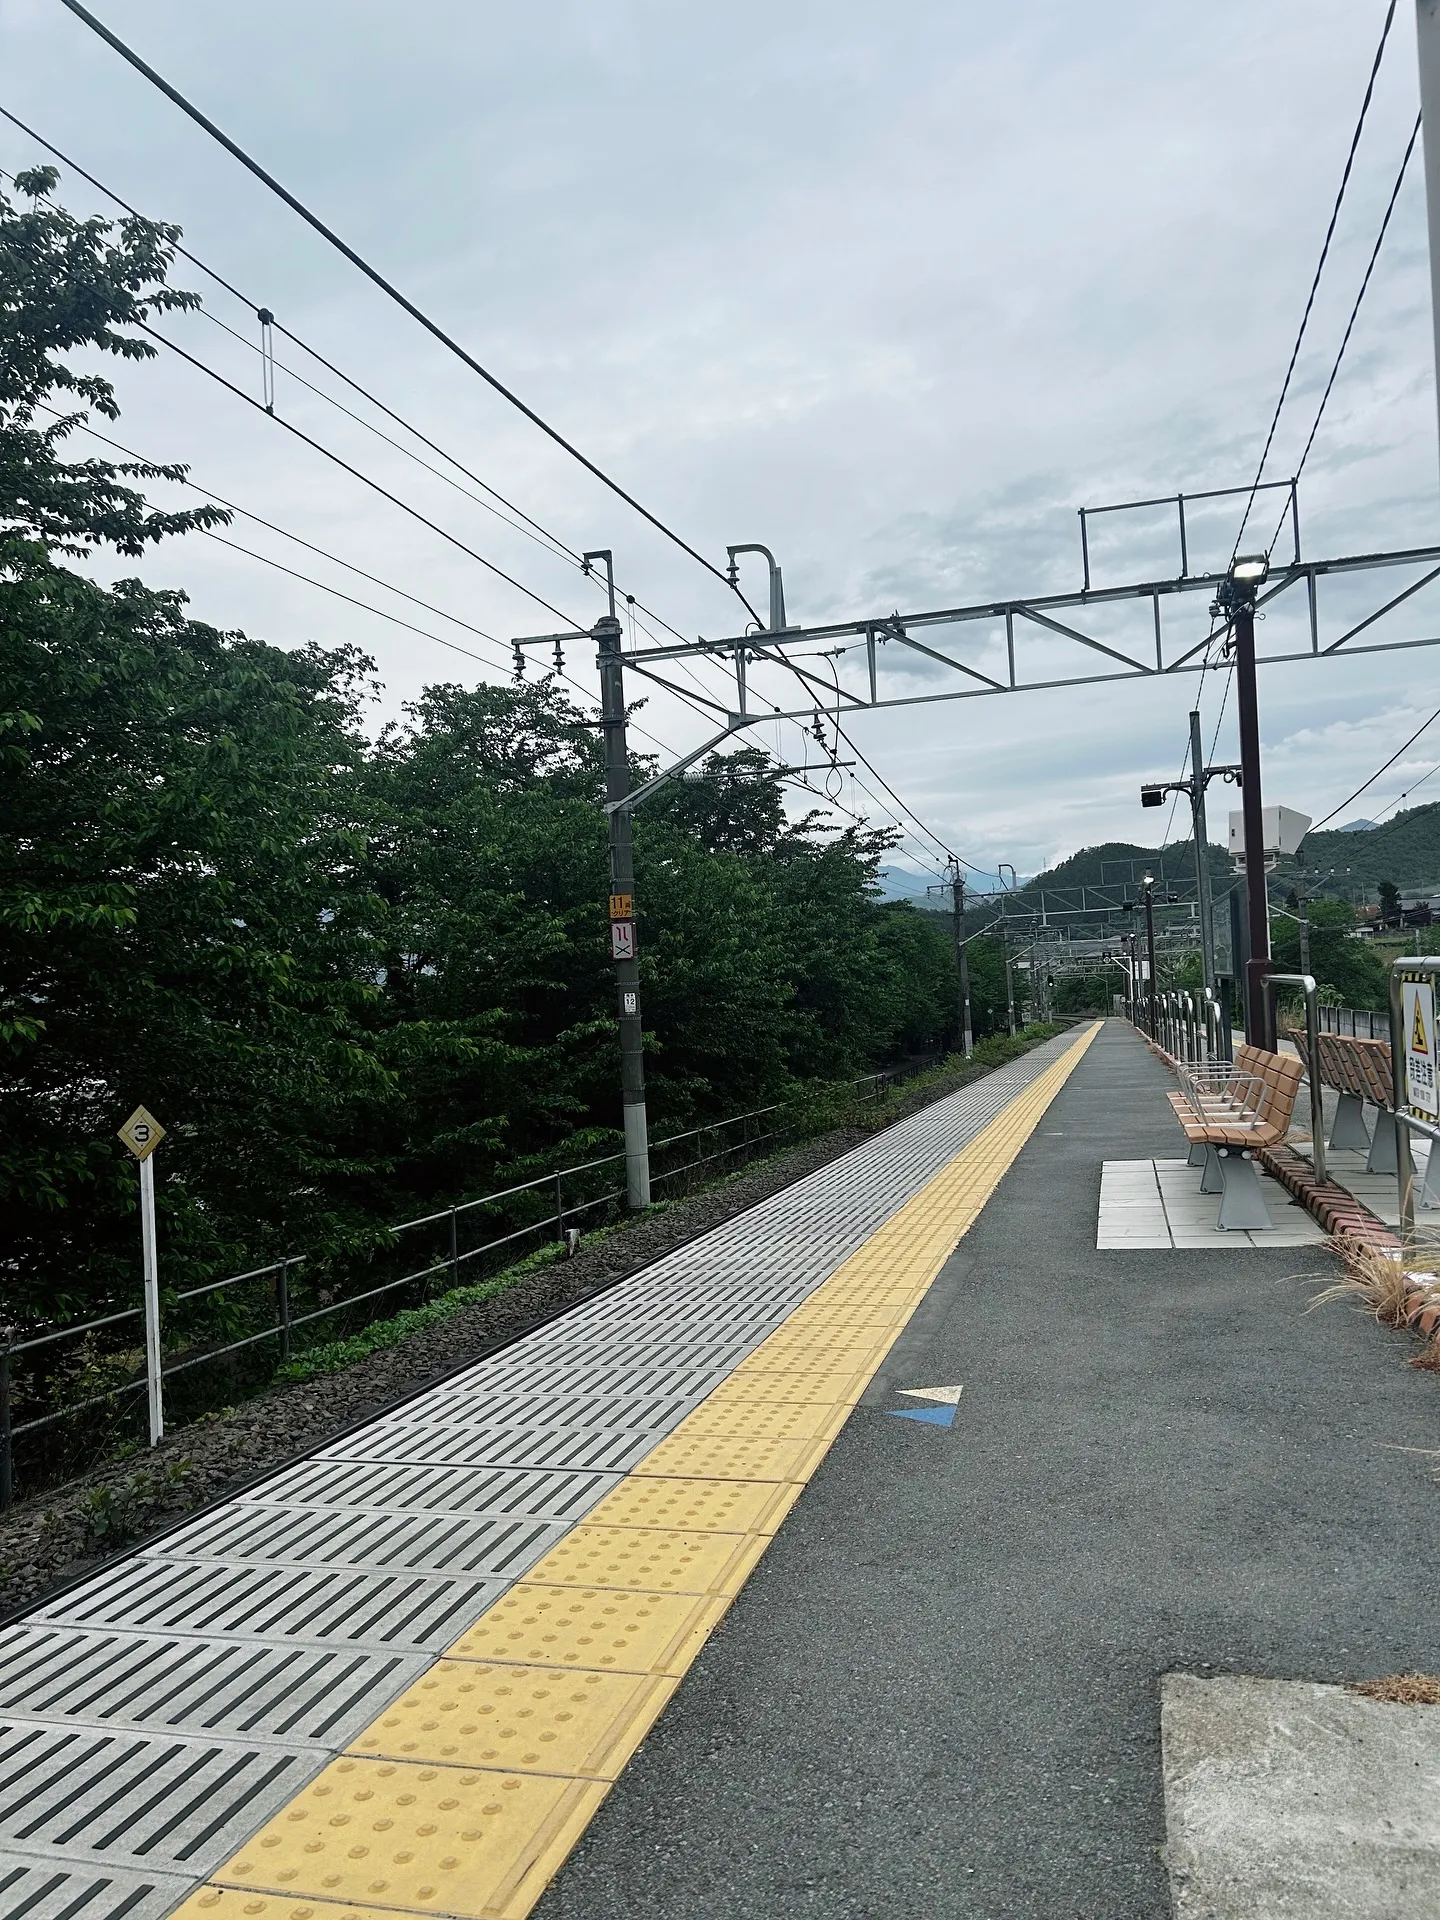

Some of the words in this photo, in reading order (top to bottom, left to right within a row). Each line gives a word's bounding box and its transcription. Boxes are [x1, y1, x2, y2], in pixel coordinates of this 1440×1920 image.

[1409, 1056, 1434, 1089] 段差注意
[134, 1125, 150, 1143] 3
